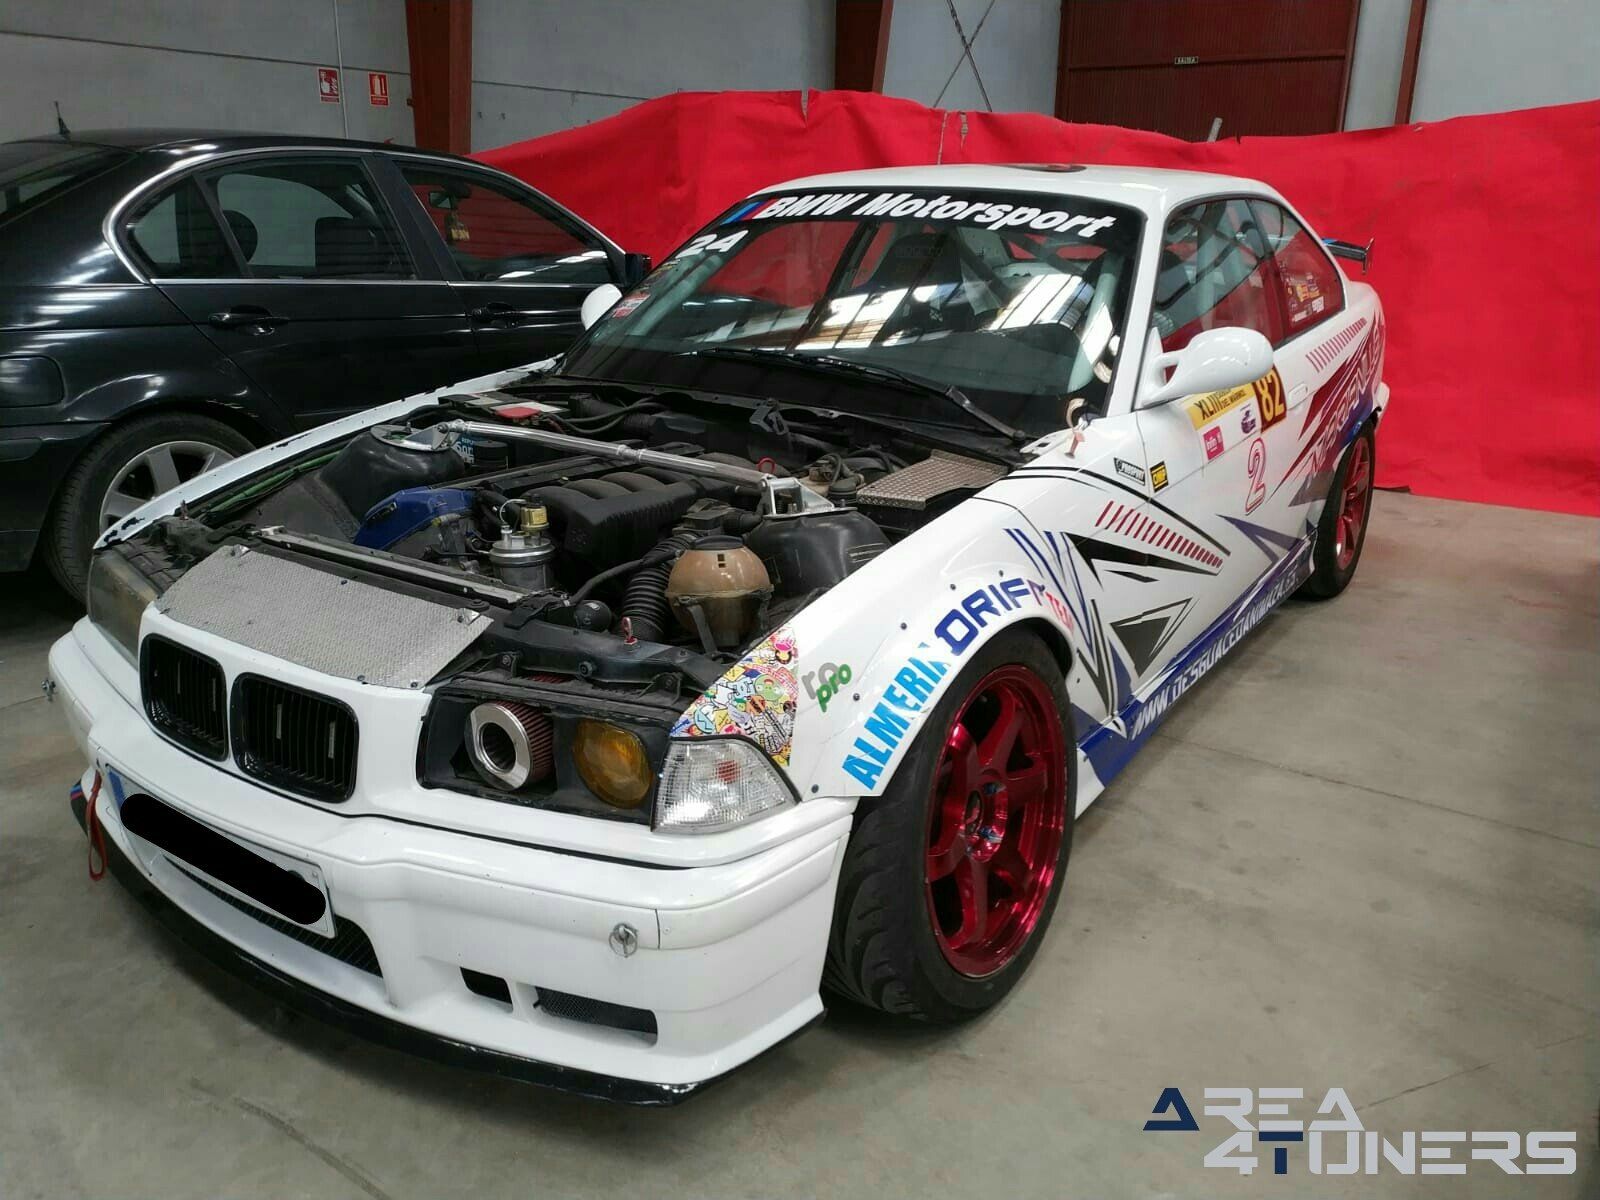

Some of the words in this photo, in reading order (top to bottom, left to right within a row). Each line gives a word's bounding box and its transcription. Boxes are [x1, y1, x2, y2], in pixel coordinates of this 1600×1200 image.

[752, 193, 869, 220] BMW
[852, 192, 1117, 238] Motorsport
[674, 230, 749, 260] 24
[1256, 371, 1284, 422] 82
[1245, 437, 1266, 516] 2
